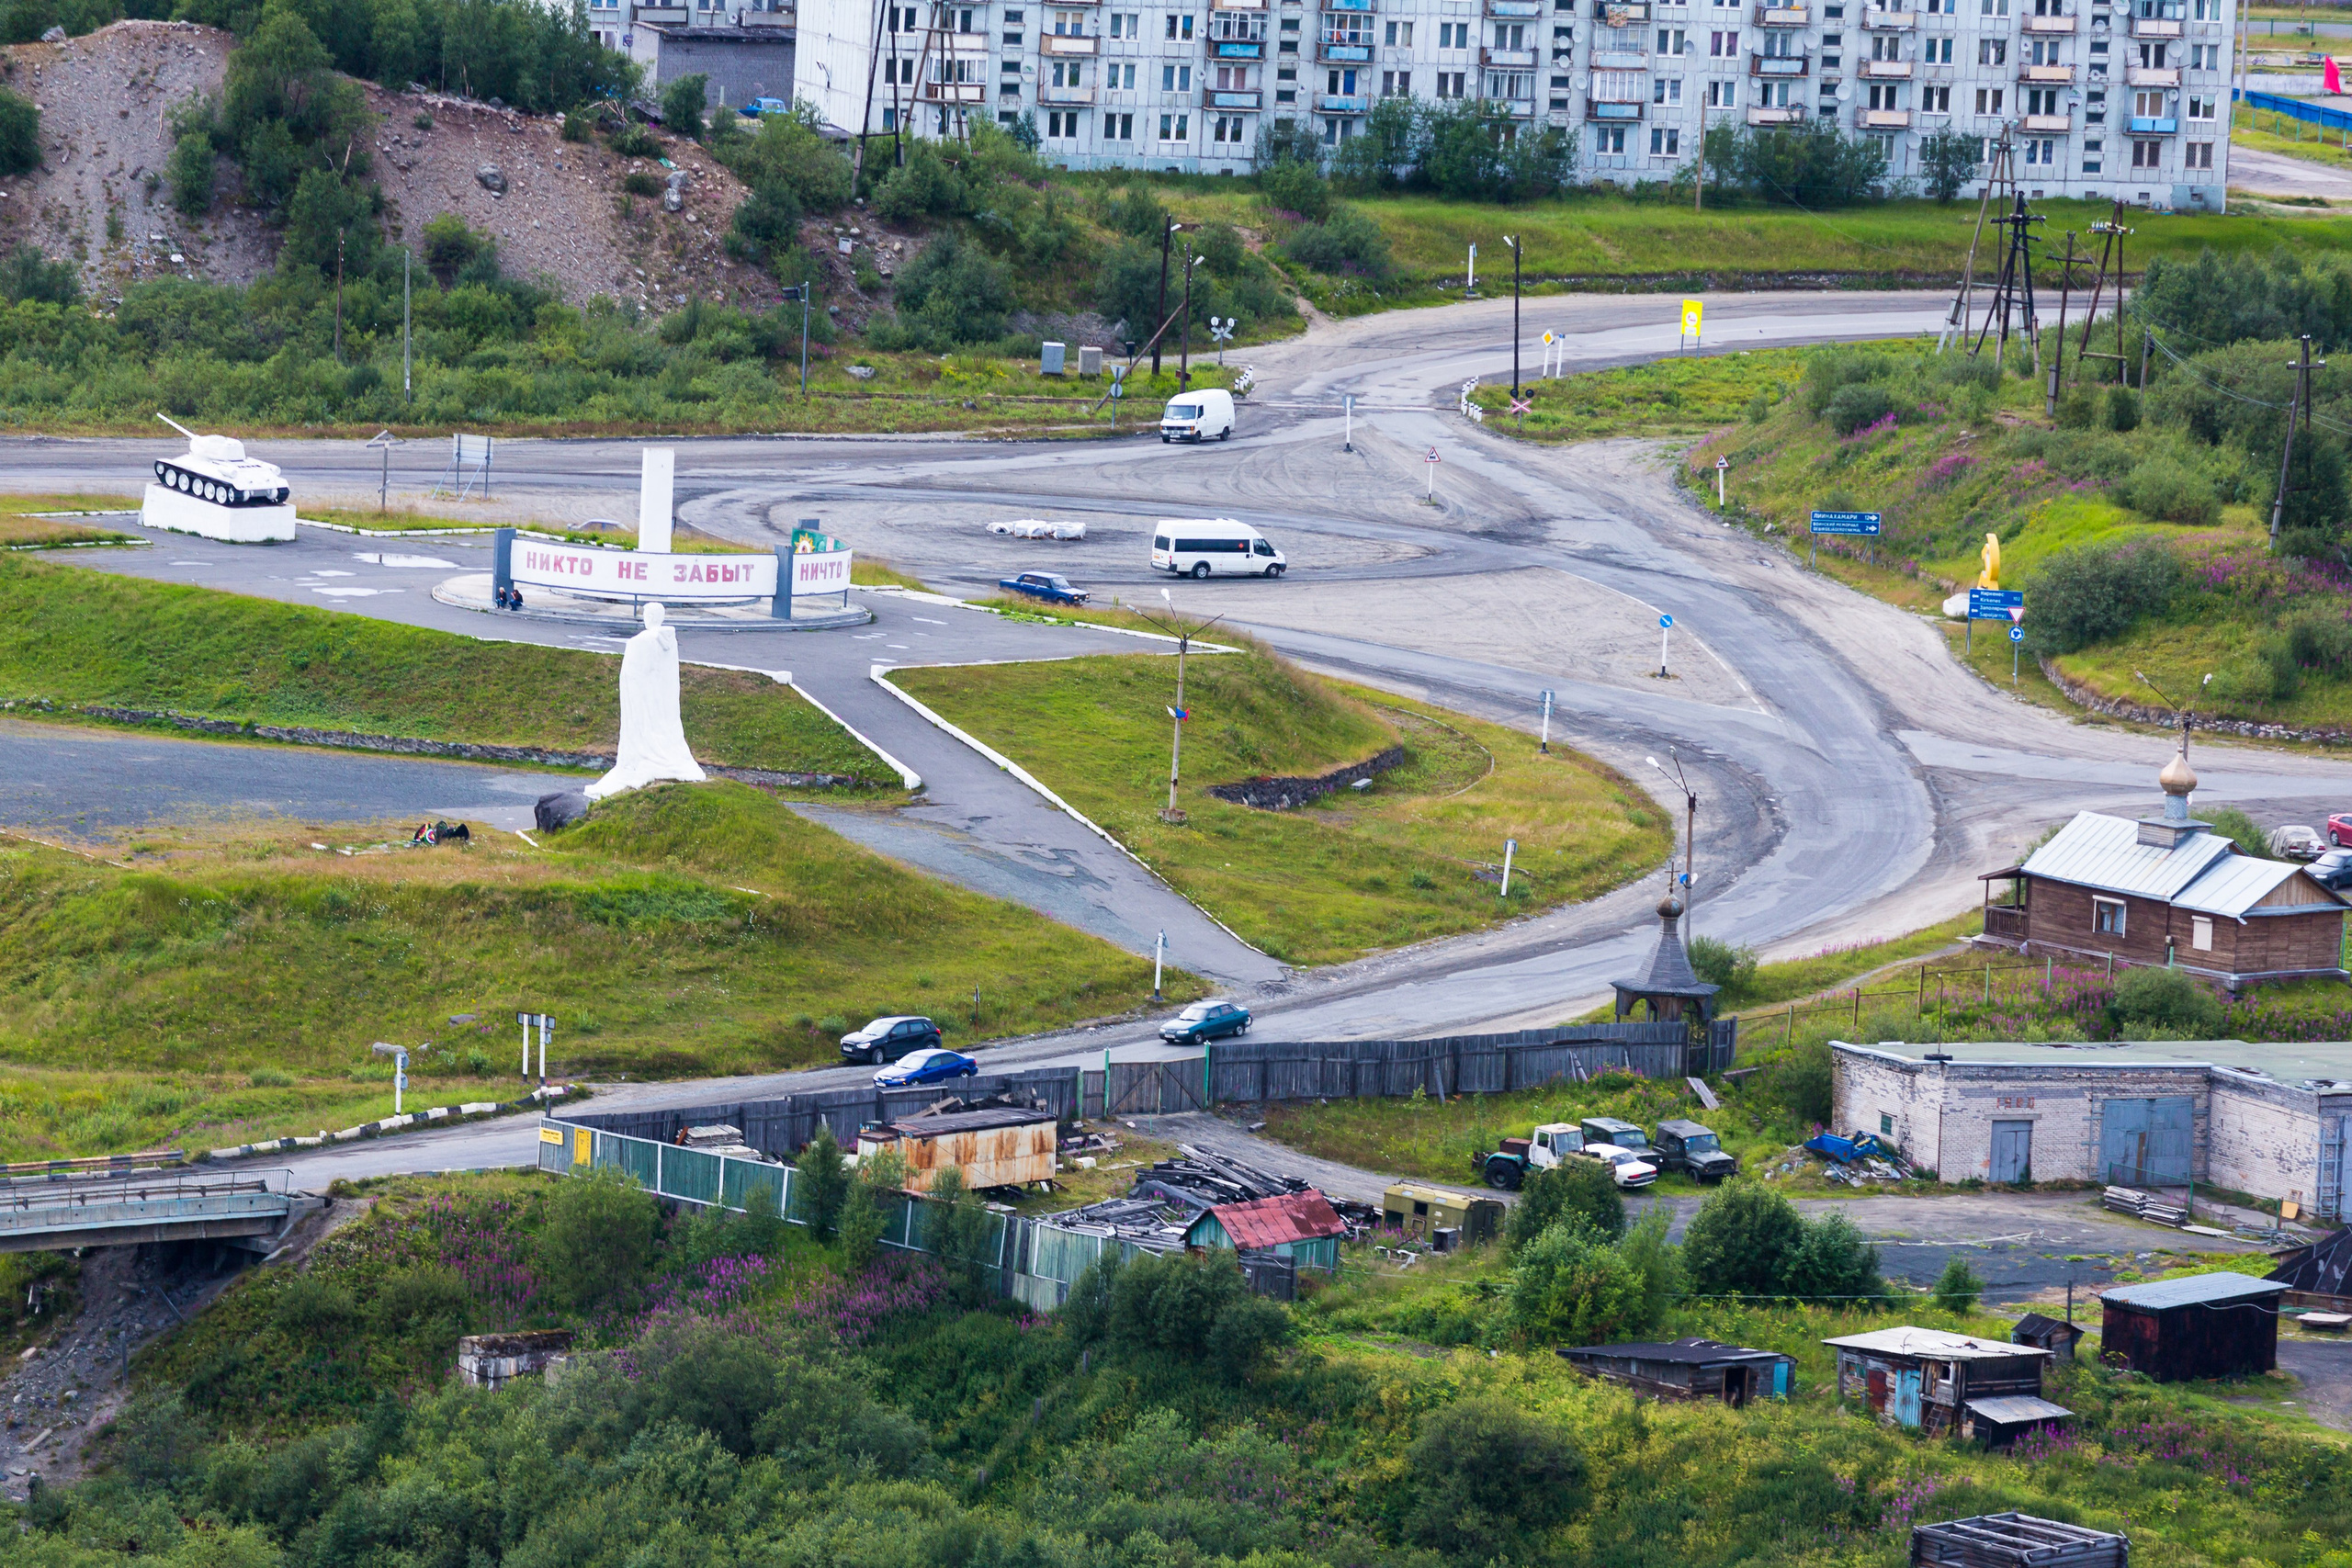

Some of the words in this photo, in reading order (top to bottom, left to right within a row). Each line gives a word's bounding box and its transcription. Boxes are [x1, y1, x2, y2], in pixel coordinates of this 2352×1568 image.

[526, 551, 593, 576] НИКТО
[617, 560, 648, 581] НЕ
[673, 563, 754, 583] ЗАБЫТ
[800, 560, 842, 581] НИЧТО
